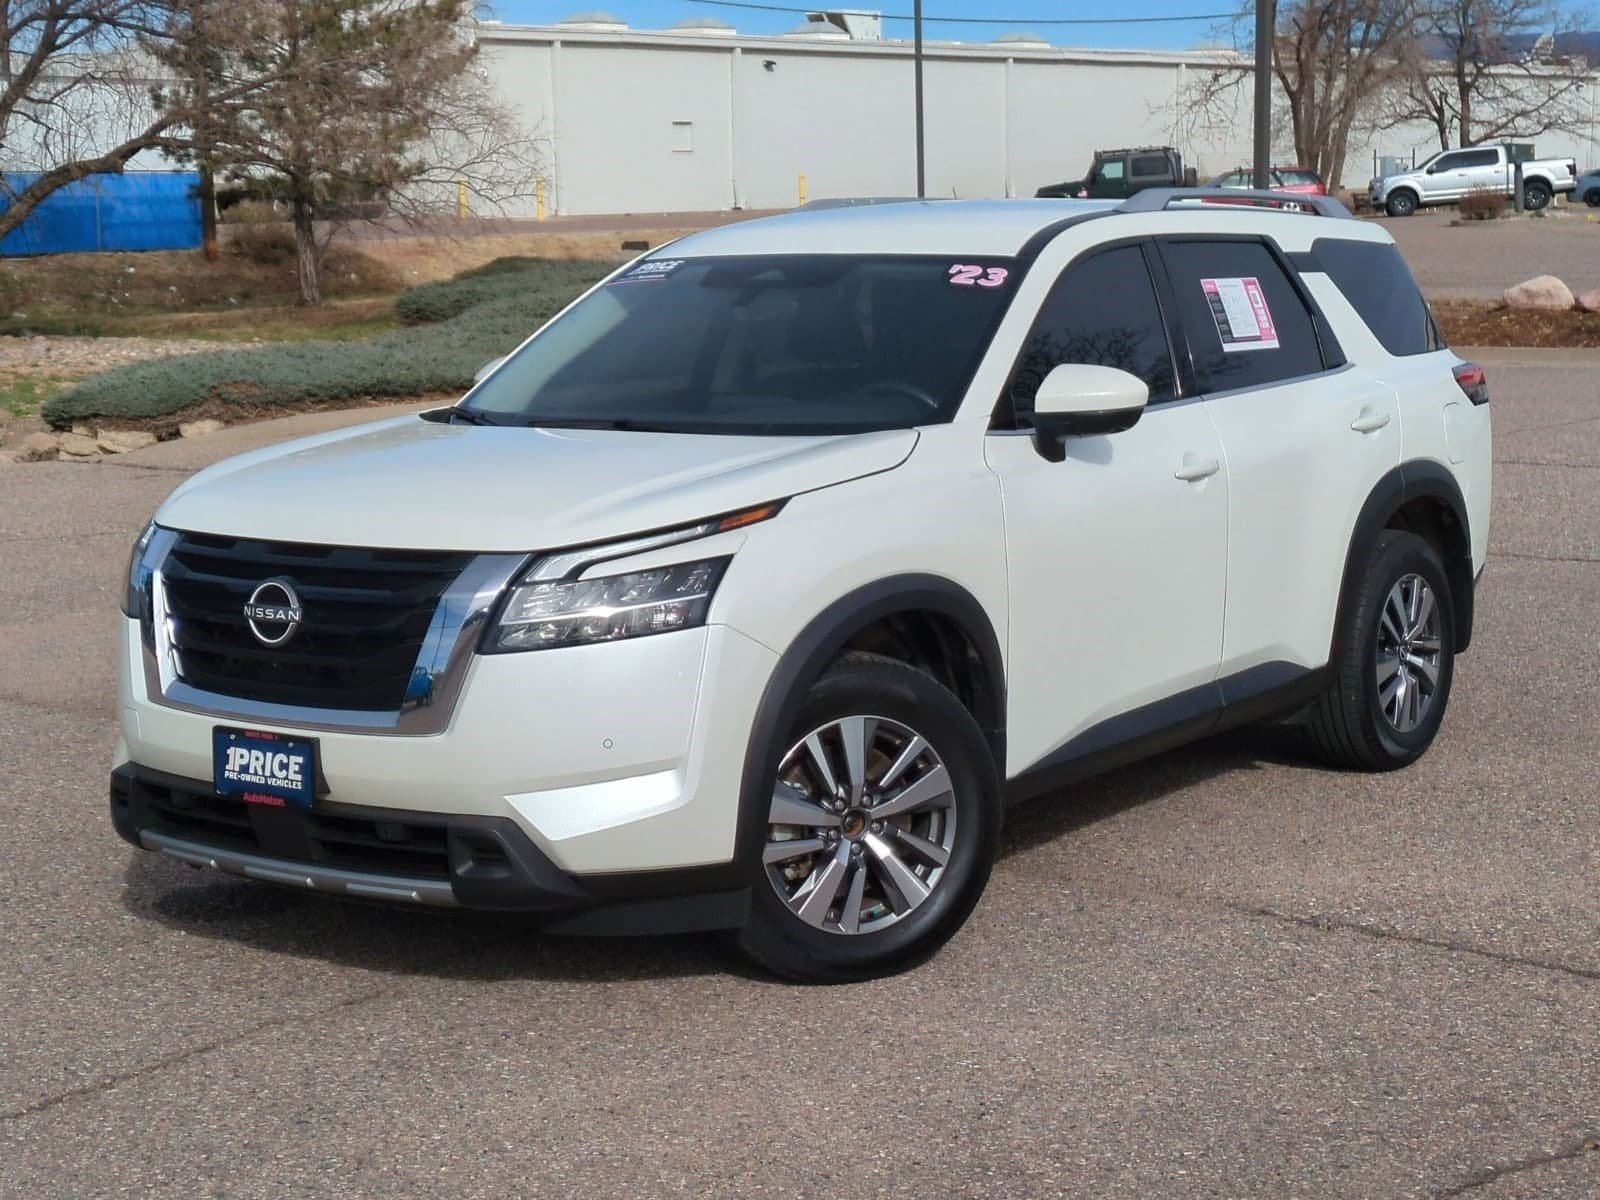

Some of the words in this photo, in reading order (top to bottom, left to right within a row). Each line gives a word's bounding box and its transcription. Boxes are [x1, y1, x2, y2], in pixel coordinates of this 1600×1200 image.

[948, 264, 1008, 287] '23
[243, 605, 299, 620] NISSAN
[224, 770, 265, 784] PRE-OWNED
[266, 777, 302, 790] VEHICLES
